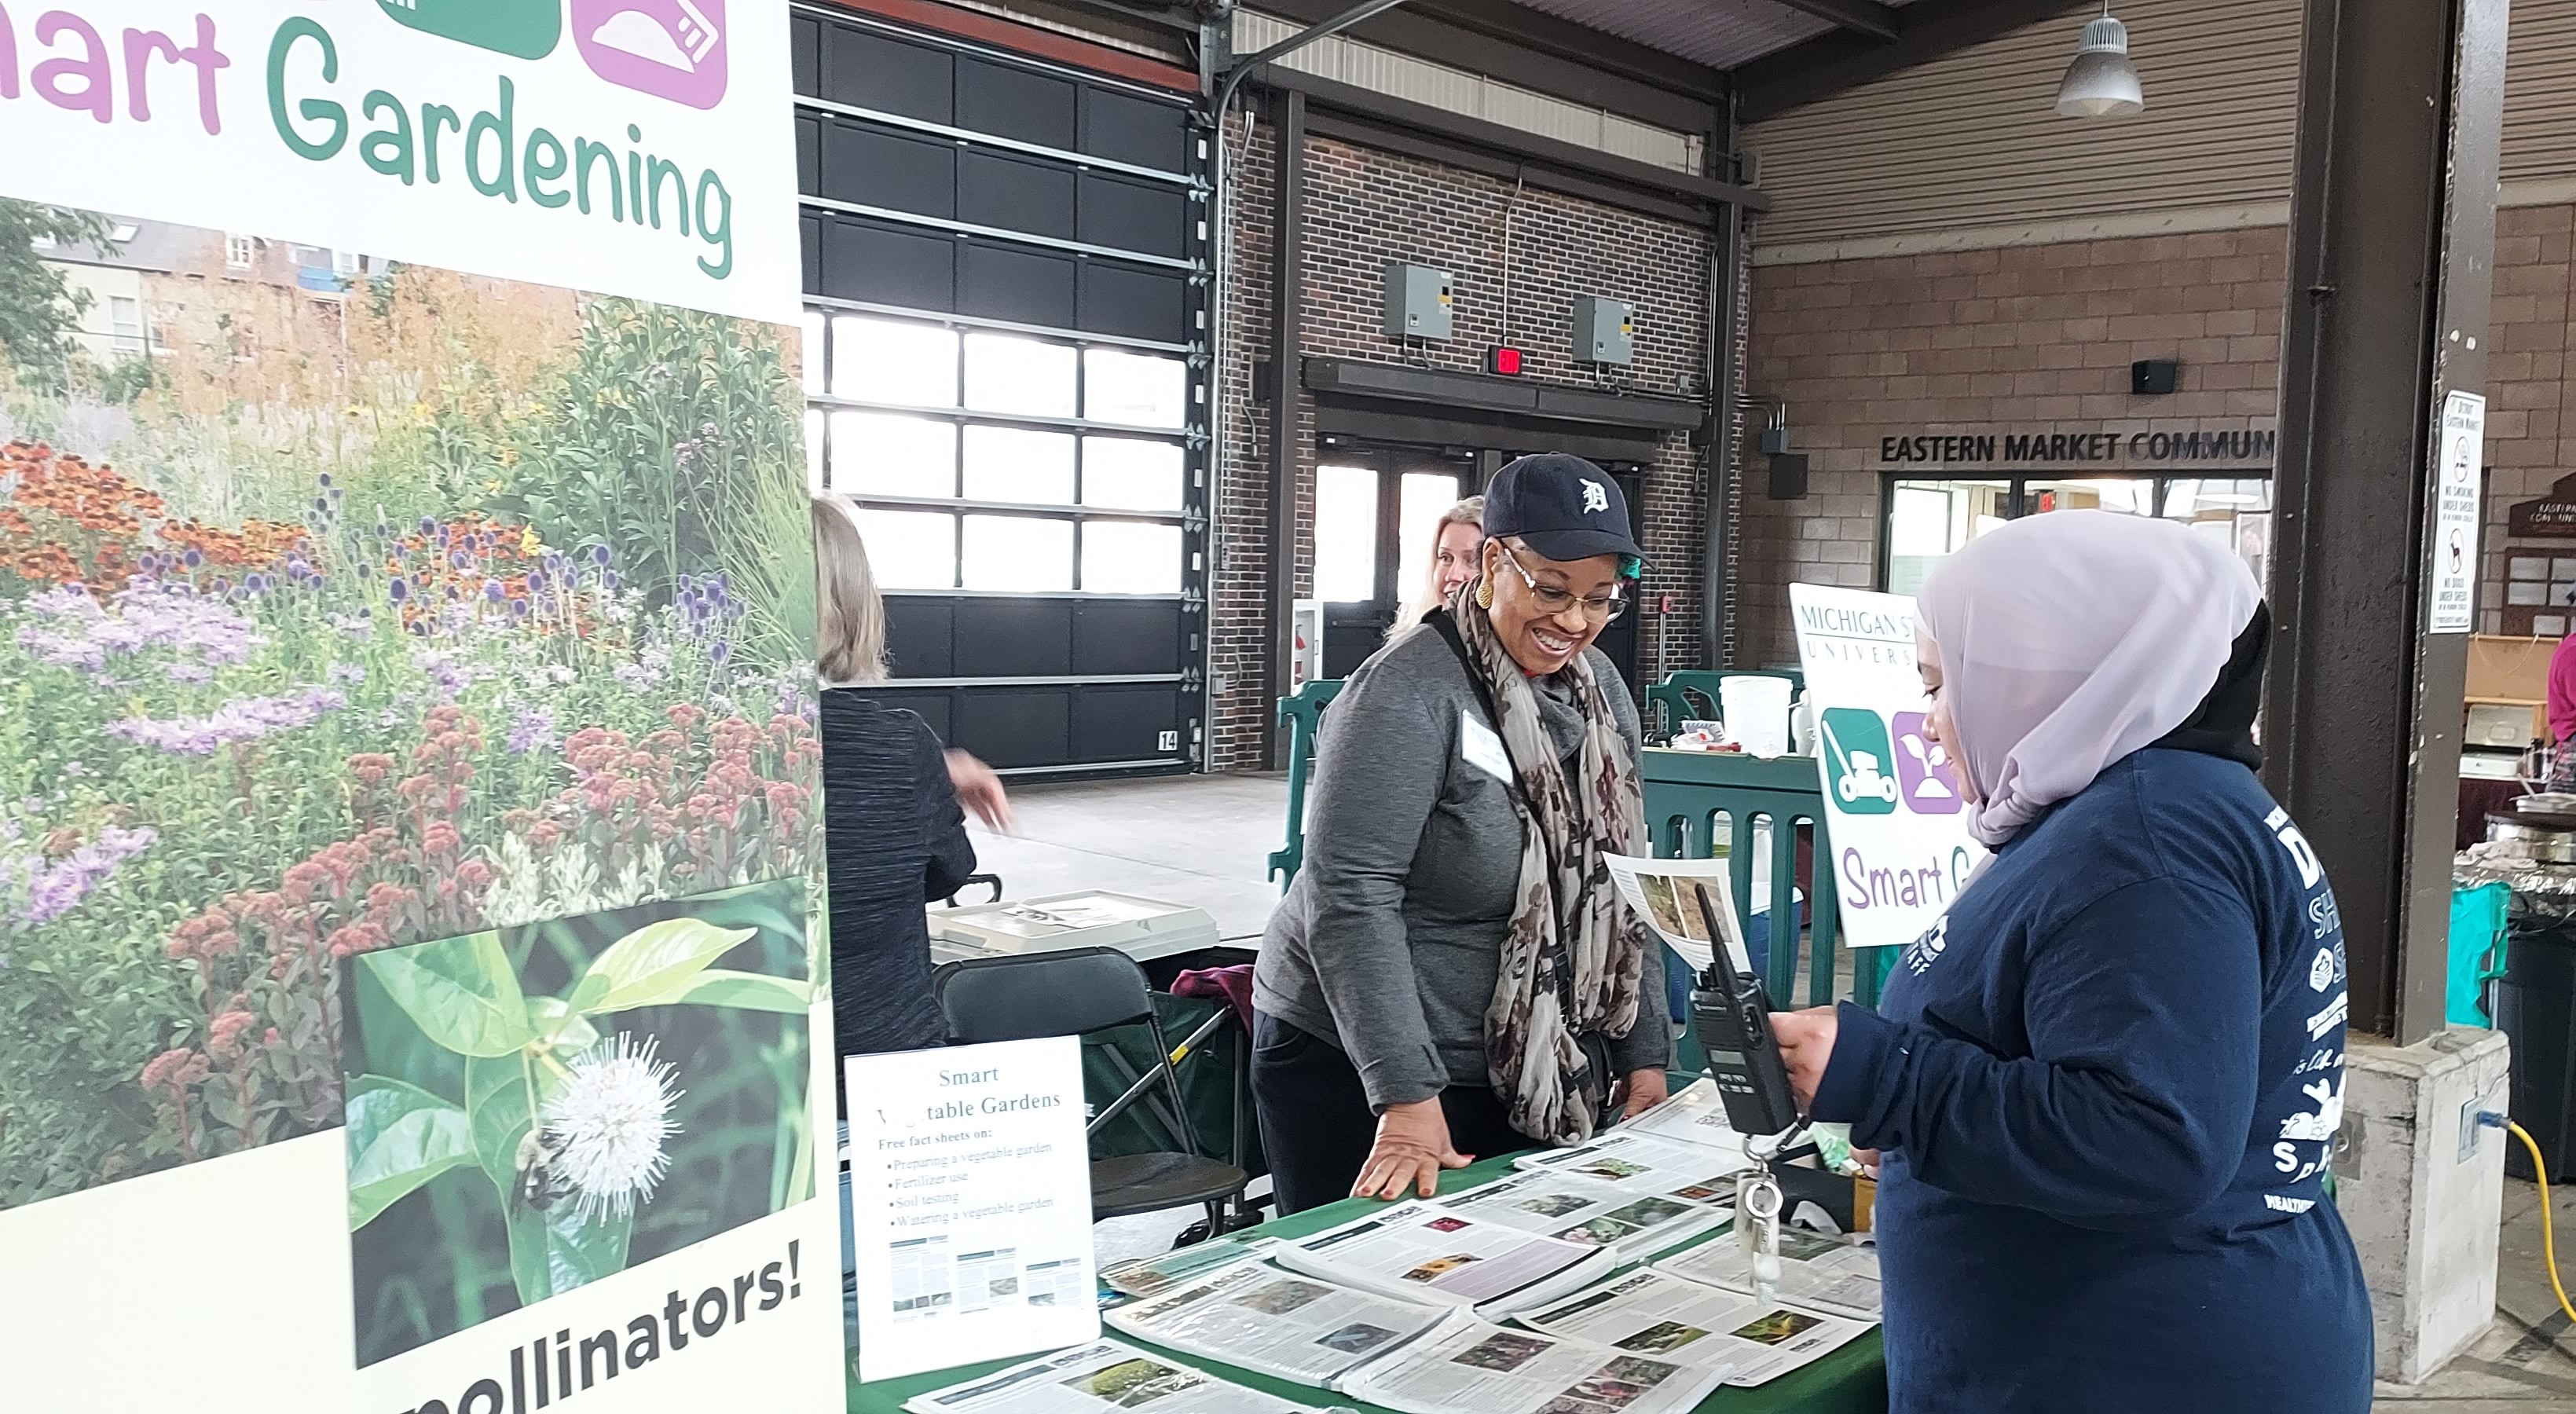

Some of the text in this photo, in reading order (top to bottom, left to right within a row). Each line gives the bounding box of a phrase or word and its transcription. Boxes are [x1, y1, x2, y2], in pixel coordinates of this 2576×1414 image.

[266, 16, 732, 280] Gardening
[1881, 430, 2276, 462] EASTERN MARKET COMMUN
[1578, 478, 1610, 515] D
[1801, 605, 1896, 635] MICHIGAN
[1807, 640, 1911, 665] UNIVERS
[1162, 732, 1176, 749] 14
[1843, 847, 1943, 909] Smart
[939, 1067, 1000, 1087] Smart
[981, 1093, 1061, 1115] Gardens
[878, 1129, 992, 1150] Free fact sheets on:
[893, 1156, 948, 1171] Preparing
[962, 1146, 1013, 1163] vegetable
[1017, 1142, 1053, 1159] garden
[950, 1173, 969, 1182] use
[895, 1192, 960, 1208] Soil testing
[896, 1212, 949, 1226] Watering
[962, 1202, 1014, 1219] vegetable
[1017, 1197, 1054, 1214] garden
[399, 1238, 802, 1414] ollinators!
